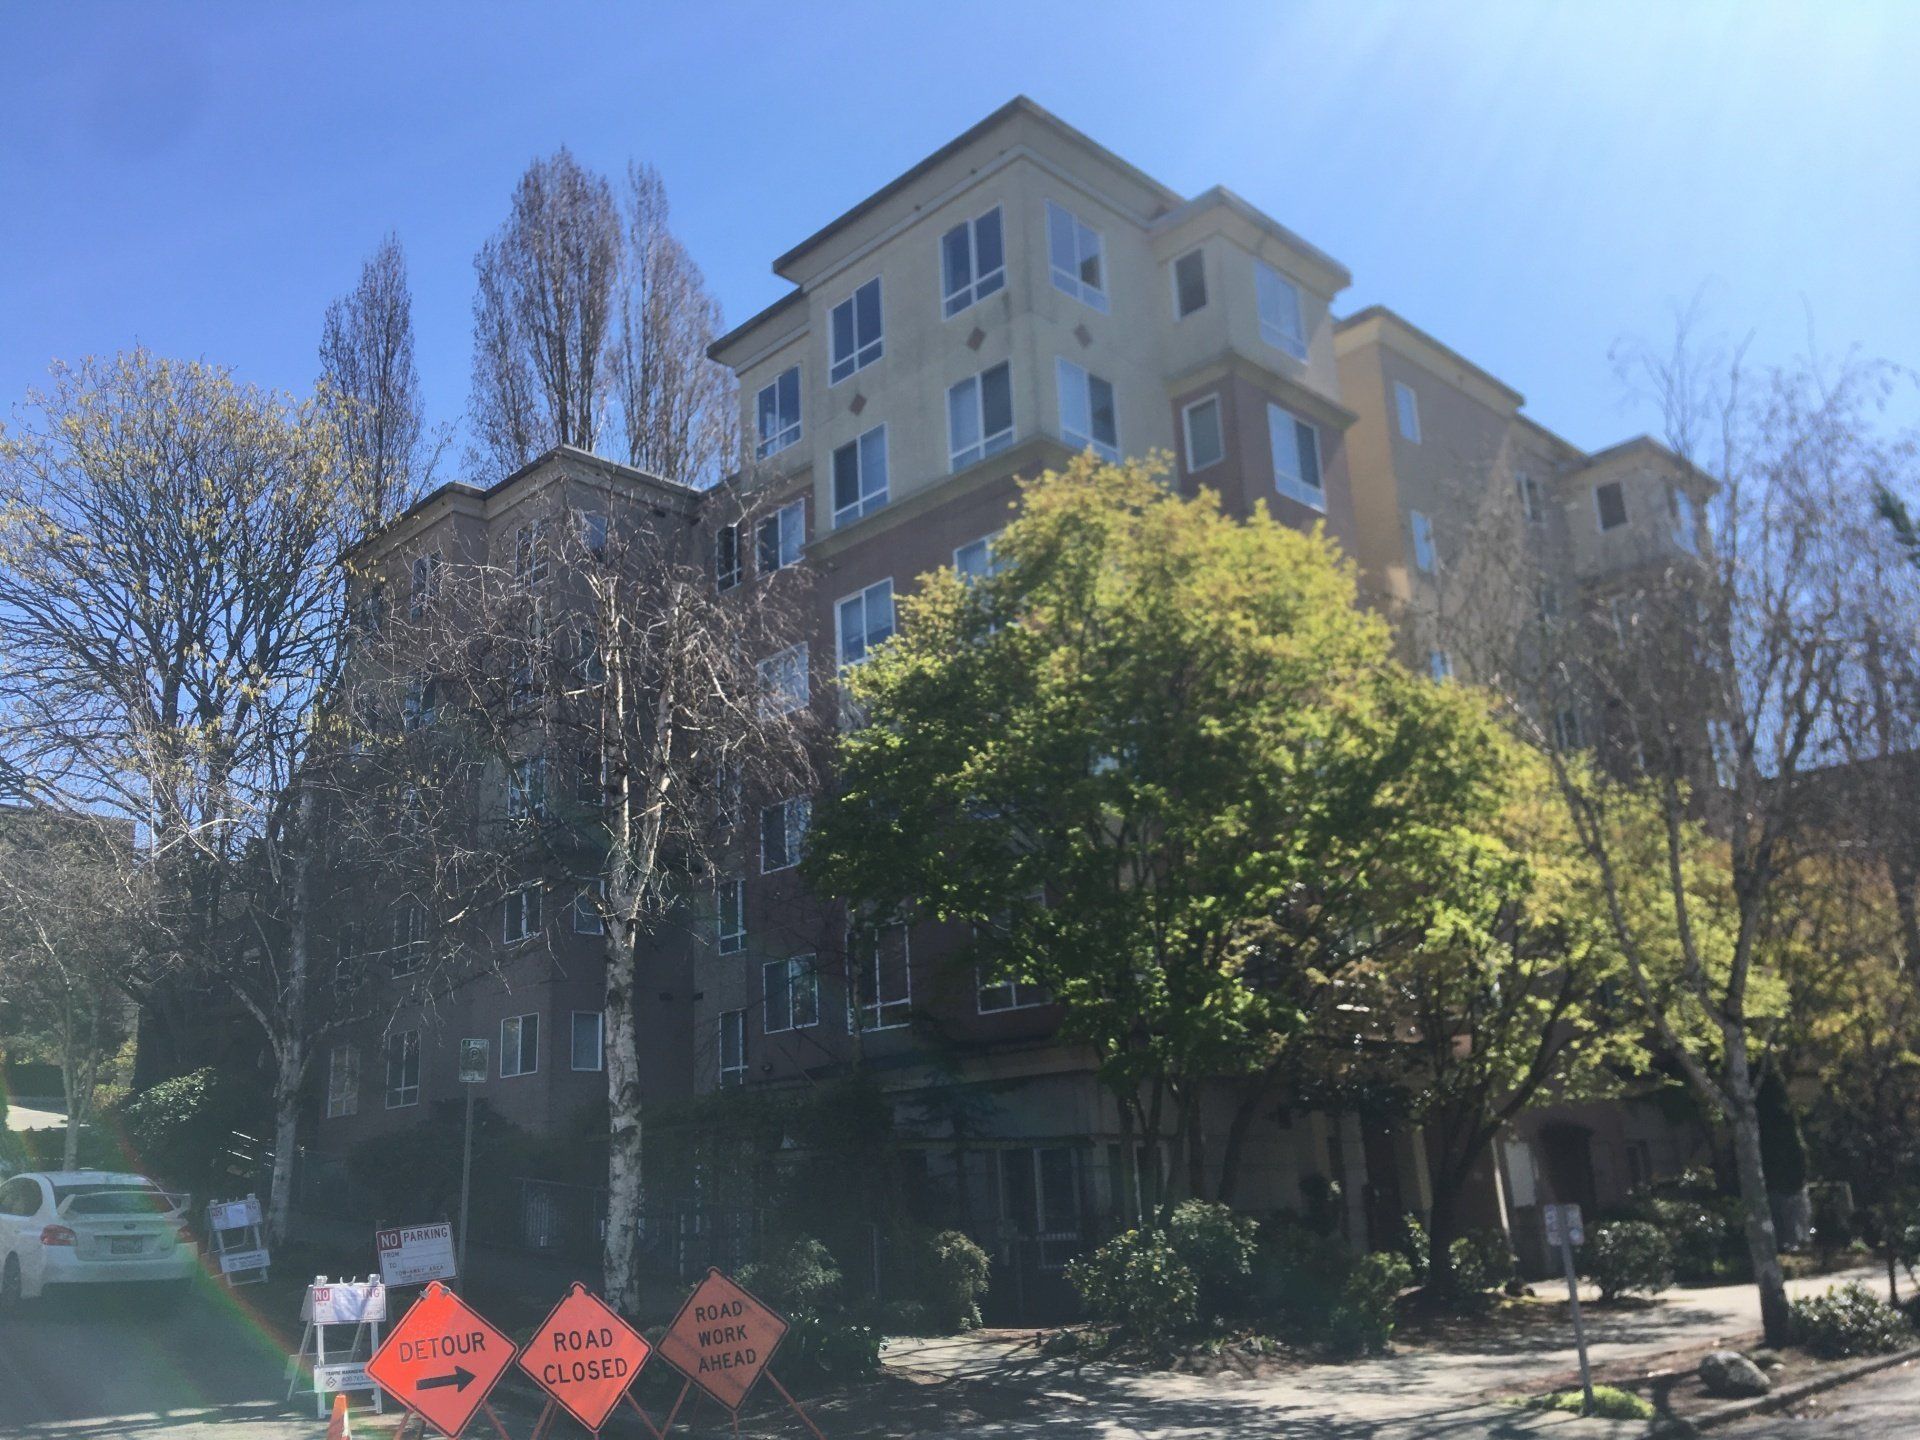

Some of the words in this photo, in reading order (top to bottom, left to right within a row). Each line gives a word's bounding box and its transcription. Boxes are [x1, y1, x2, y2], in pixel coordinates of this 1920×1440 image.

[380, 1233, 398, 1248] NO
[403, 1227, 448, 1242] PARKING
[429, 1264, 444, 1272] AREA
[315, 1289, 329, 1300] NO
[695, 1301, 742, 1323] ROAD
[400, 1332, 485, 1362] DETOUR
[554, 1328, 612, 1352] ROAD
[698, 1324, 748, 1347] WORK
[543, 1358, 627, 1385] CLOSED
[699, 1348, 756, 1373] AHEAD
